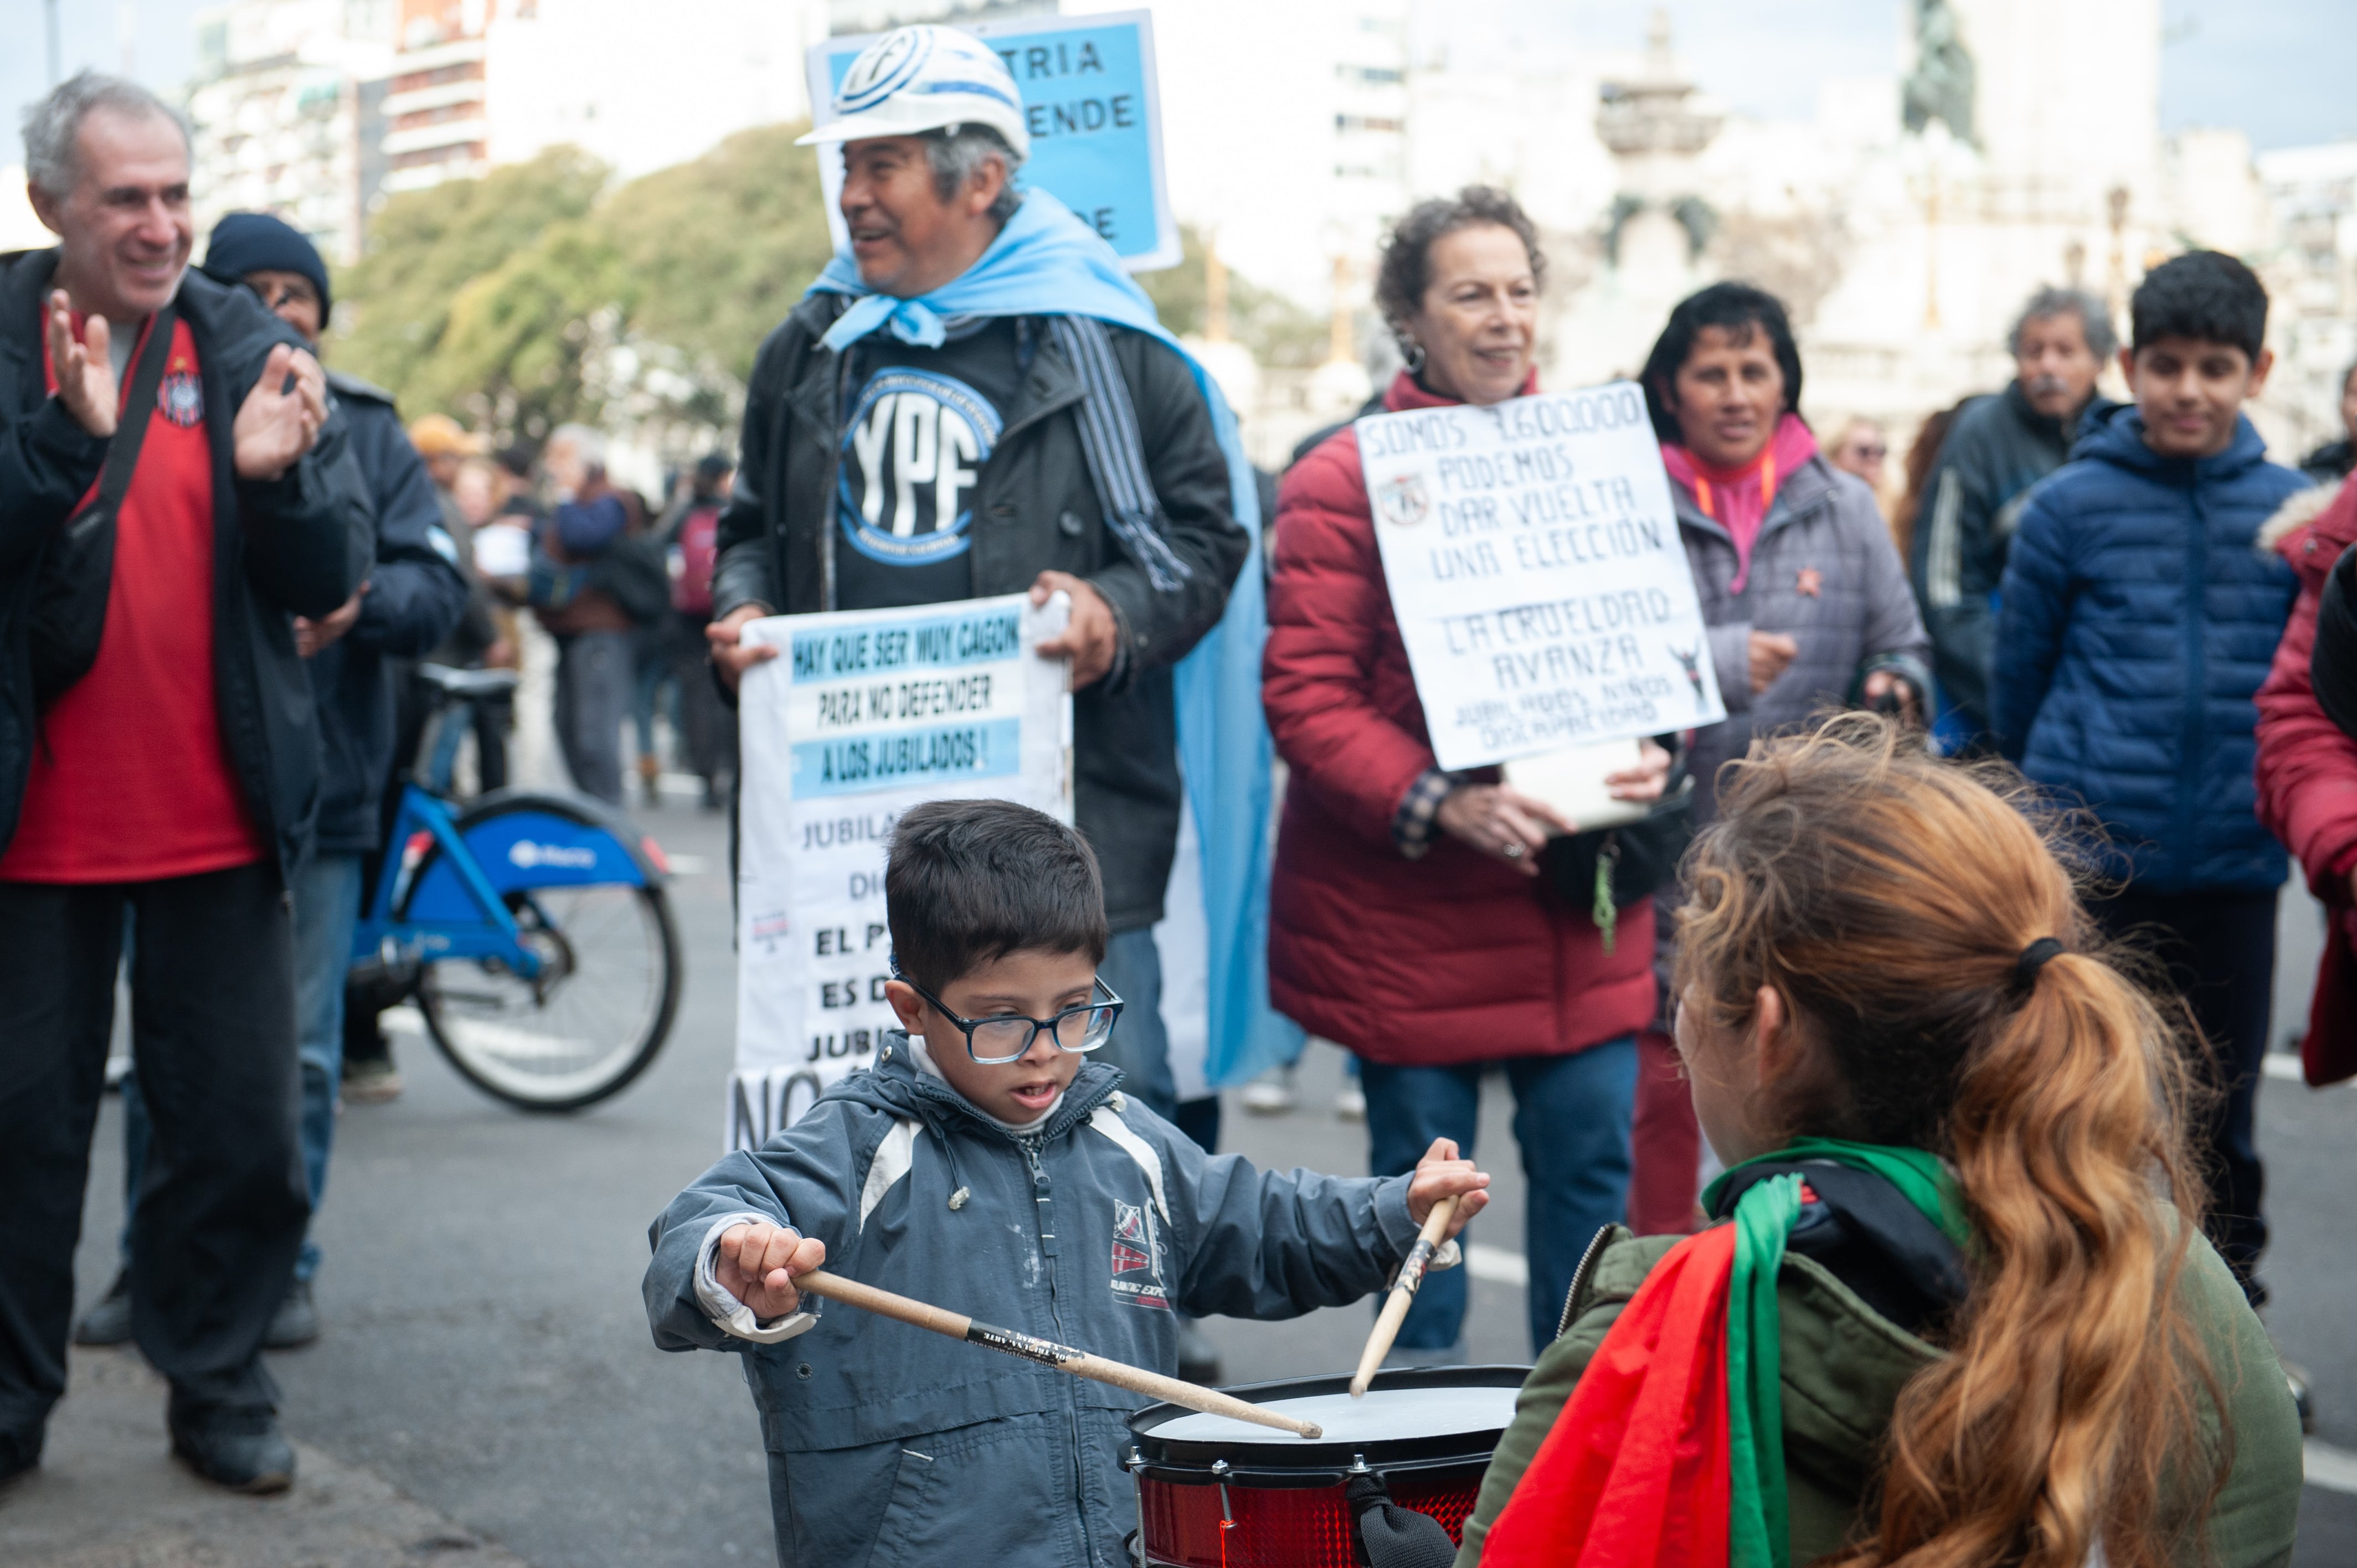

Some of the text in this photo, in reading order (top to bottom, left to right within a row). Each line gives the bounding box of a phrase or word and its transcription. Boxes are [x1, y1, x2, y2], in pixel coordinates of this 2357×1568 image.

[1366, 408, 1466, 457] SOMOS
[853, 392, 978, 538] YPF
[1437, 445, 1574, 493] PODEMOS
[1438, 495, 1502, 537] DAR
[1509, 476, 1636, 527] VUELTA
[1429, 540, 1502, 581] UNA
[1442, 587, 1671, 655] LA CRUELDAD
[793, 637, 825, 679] HAY
[832, 634, 868, 674] QUE
[874, 630, 908, 666] SER
[916, 624, 951, 662] MUY
[1493, 633, 1644, 689] AVANZA
[817, 674, 992, 730] PARA NO DEFENDER
[821, 745, 833, 786] A
[837, 741, 868, 781] LOS
[850, 871, 886, 900] DI
[816, 928, 853, 956] EL
[821, 978, 856, 1009] ES
